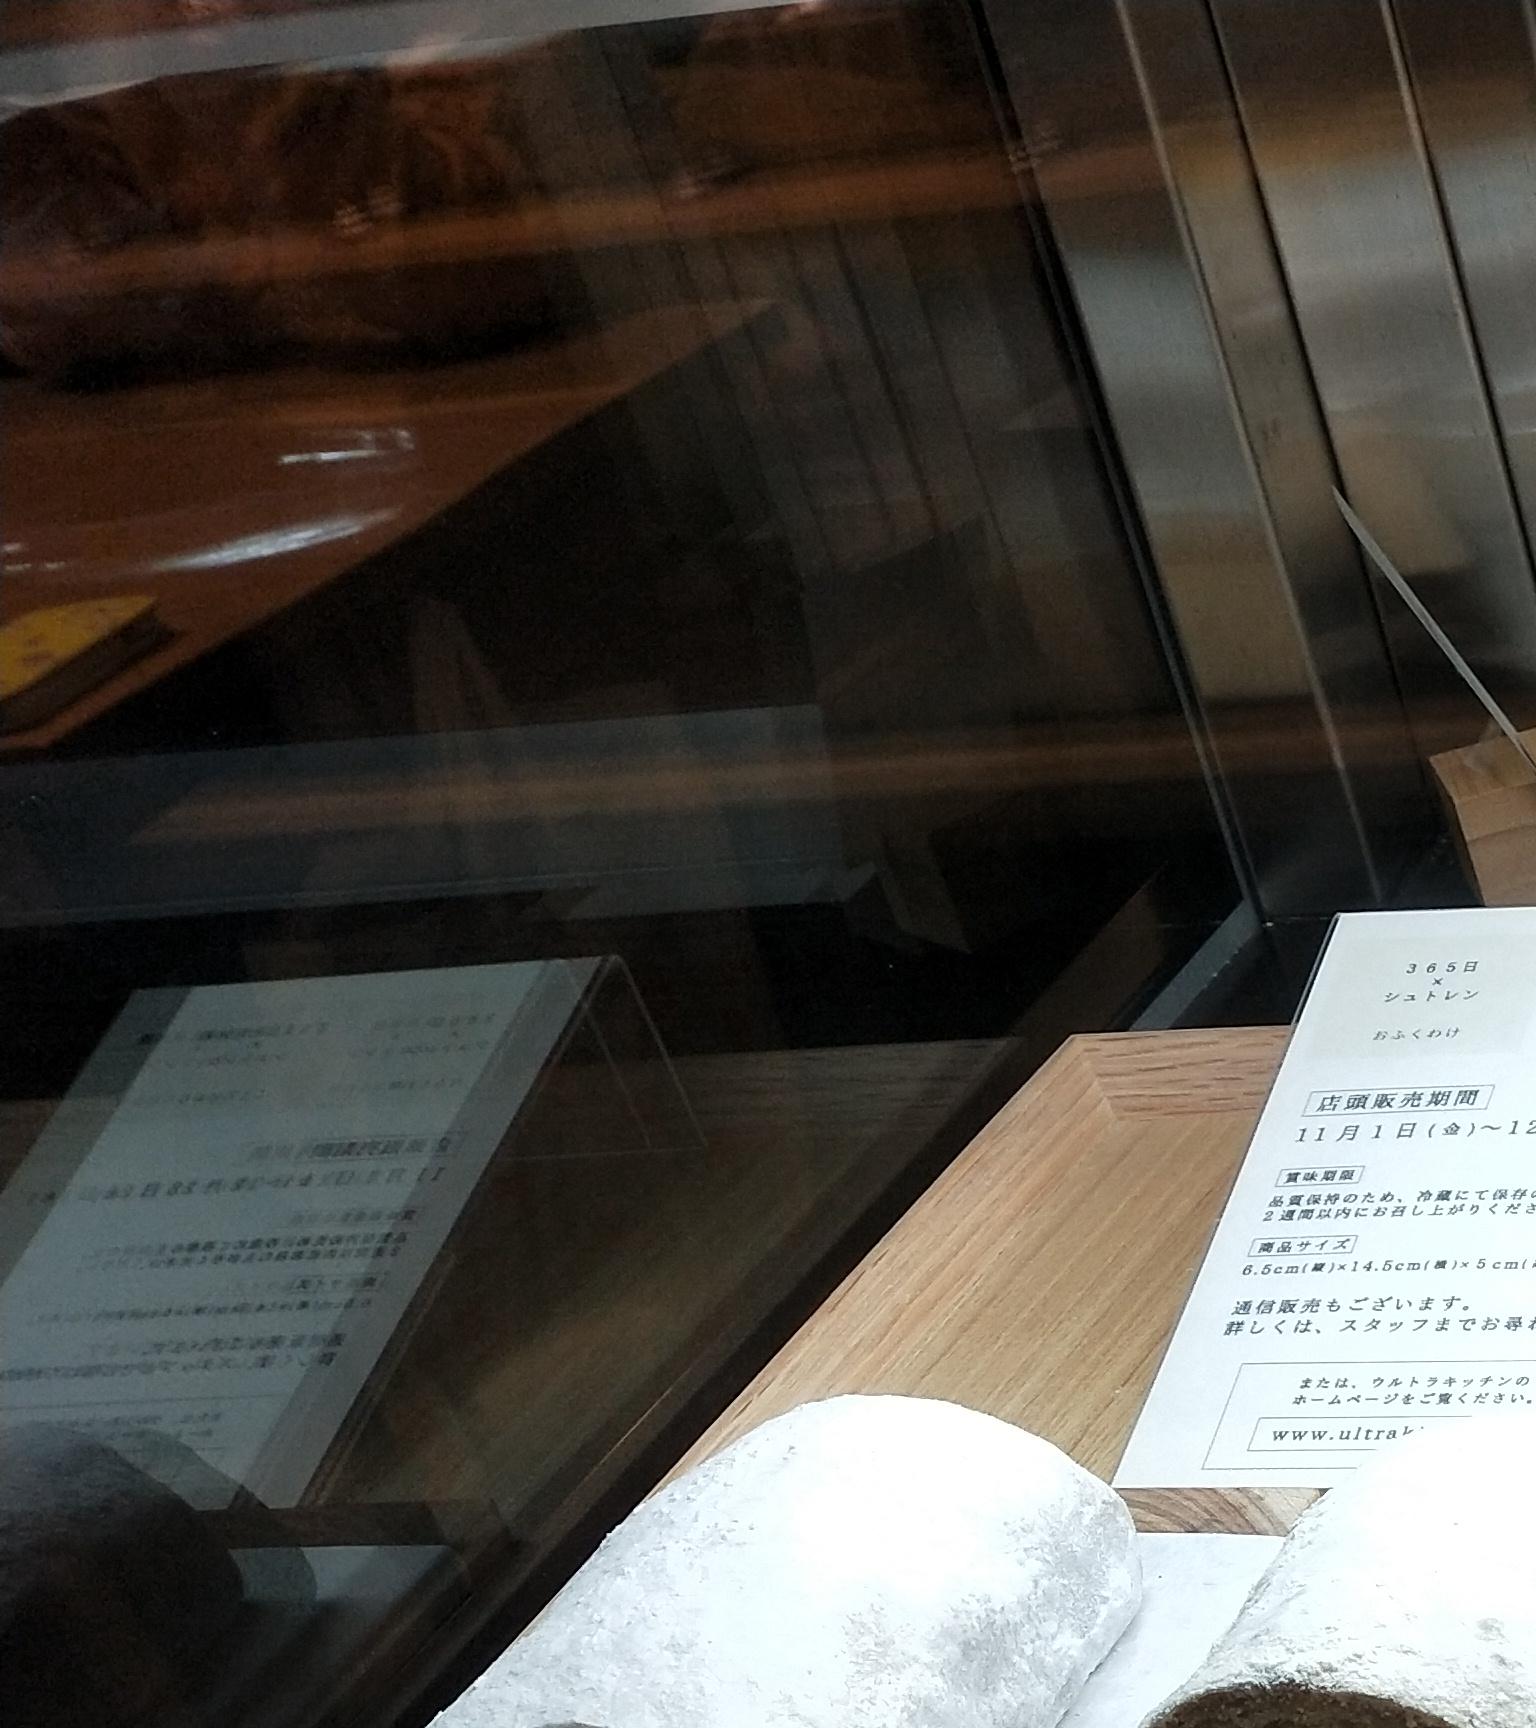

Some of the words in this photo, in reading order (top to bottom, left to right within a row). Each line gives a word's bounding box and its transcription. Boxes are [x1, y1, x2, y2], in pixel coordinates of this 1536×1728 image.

[1405, 960, 1480, 975] 365日
[1384, 990, 1481, 1002] シュトレン
[1373, 1027, 1461, 1041] おふくわけ
[1315, 1089, 1480, 1112] 店頭販売期間
[1283, 1169, 1356, 1185] 賞味期限
[1258, 1238, 1350, 1254] 商品サイズ
[1231, 1296, 1472, 1316] 通信販売もございます。
[1299, 1375, 1531, 1389] または、ウルトラキッチンの
[1291, 1392, 1533, 1406] ホームページをご覧ください。
[1272, 1425, 1424, 1441] www.ultra
